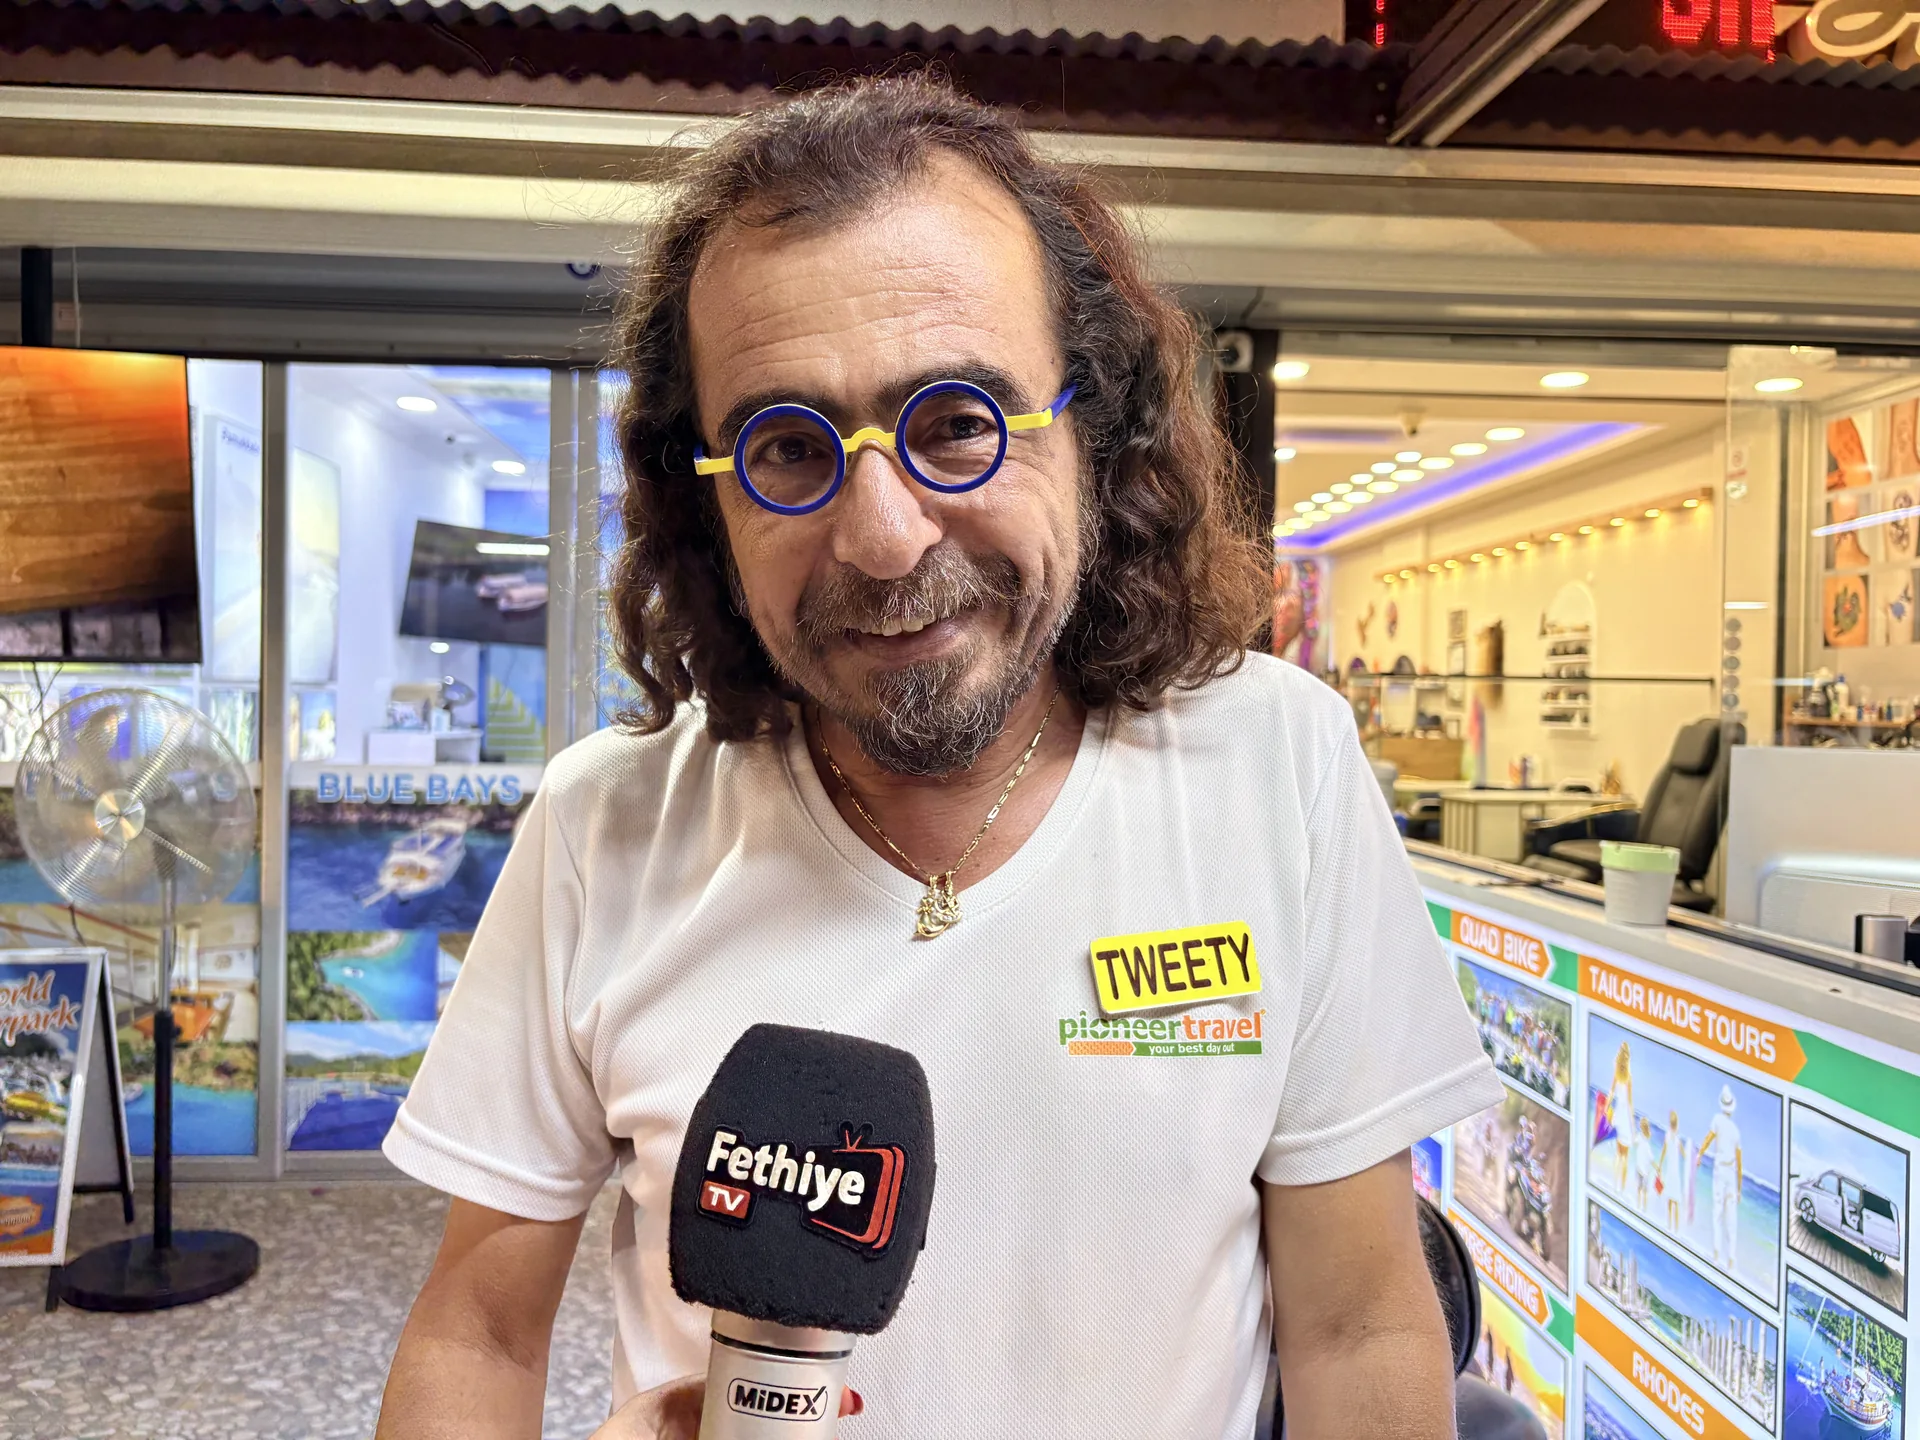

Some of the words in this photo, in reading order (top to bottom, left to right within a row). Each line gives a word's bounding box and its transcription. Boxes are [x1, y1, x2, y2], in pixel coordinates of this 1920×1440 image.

[317, 771, 416, 803] BLUE
[425, 772, 523, 805] BAYS
[1096, 933, 1250, 1000] TWEETY
[1460, 915, 1500, 956] QUAD
[1503, 931, 1541, 974] BIKE
[1588, 964, 1645, 1013] TAILOR
[1647, 987, 1702, 1035] MADE
[1703, 1008, 1776, 1065] TOURS
[1149, 1044, 1174, 1054] your
[1178, 1042, 1204, 1054] best
[1206, 1042, 1221, 1054] day
[1222, 1042, 1235, 1053] out
[706, 1130, 865, 1212] Fethiye
[708, 1186, 745, 1212] TV
[1494, 1254, 1540, 1317] RIDING
[1632, 1350, 1705, 1435] RHODES
